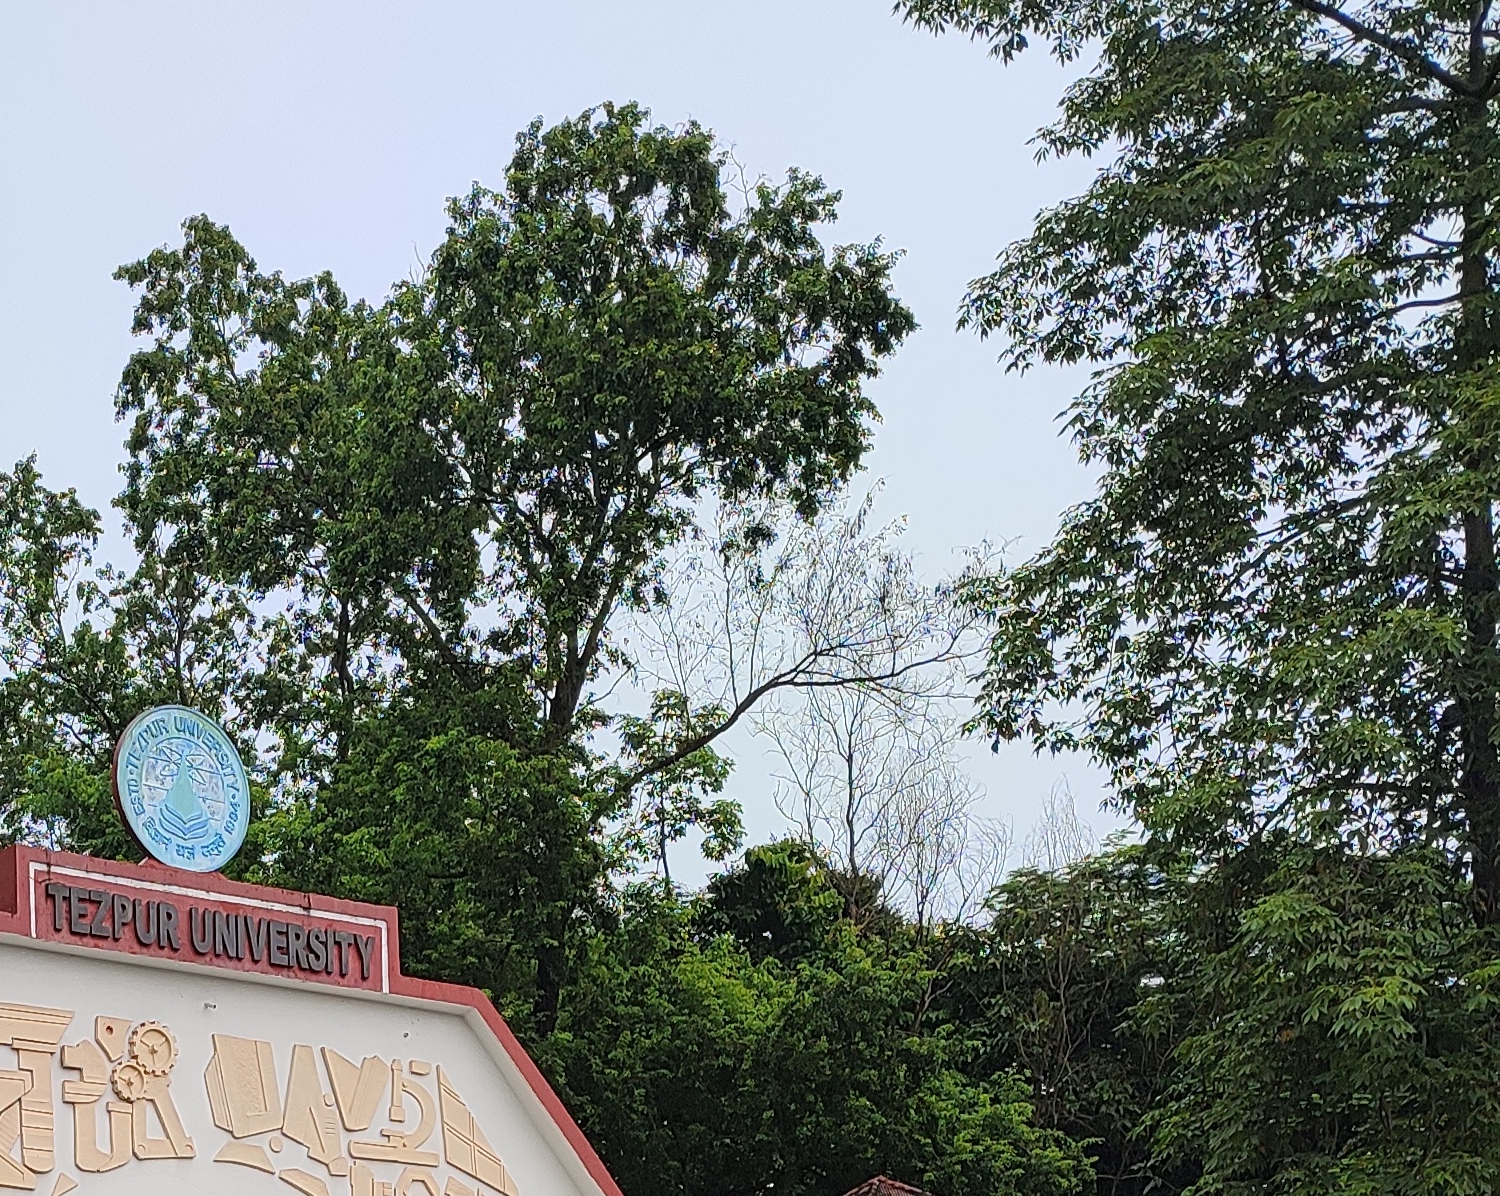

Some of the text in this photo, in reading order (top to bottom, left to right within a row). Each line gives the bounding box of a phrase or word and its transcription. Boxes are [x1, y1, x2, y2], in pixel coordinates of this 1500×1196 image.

[125, 716, 171, 771] TEZPUR
[173, 715, 241, 793] UNIVERSITY
[46, 882, 375, 979] TEZPUR UNIVERSITY
